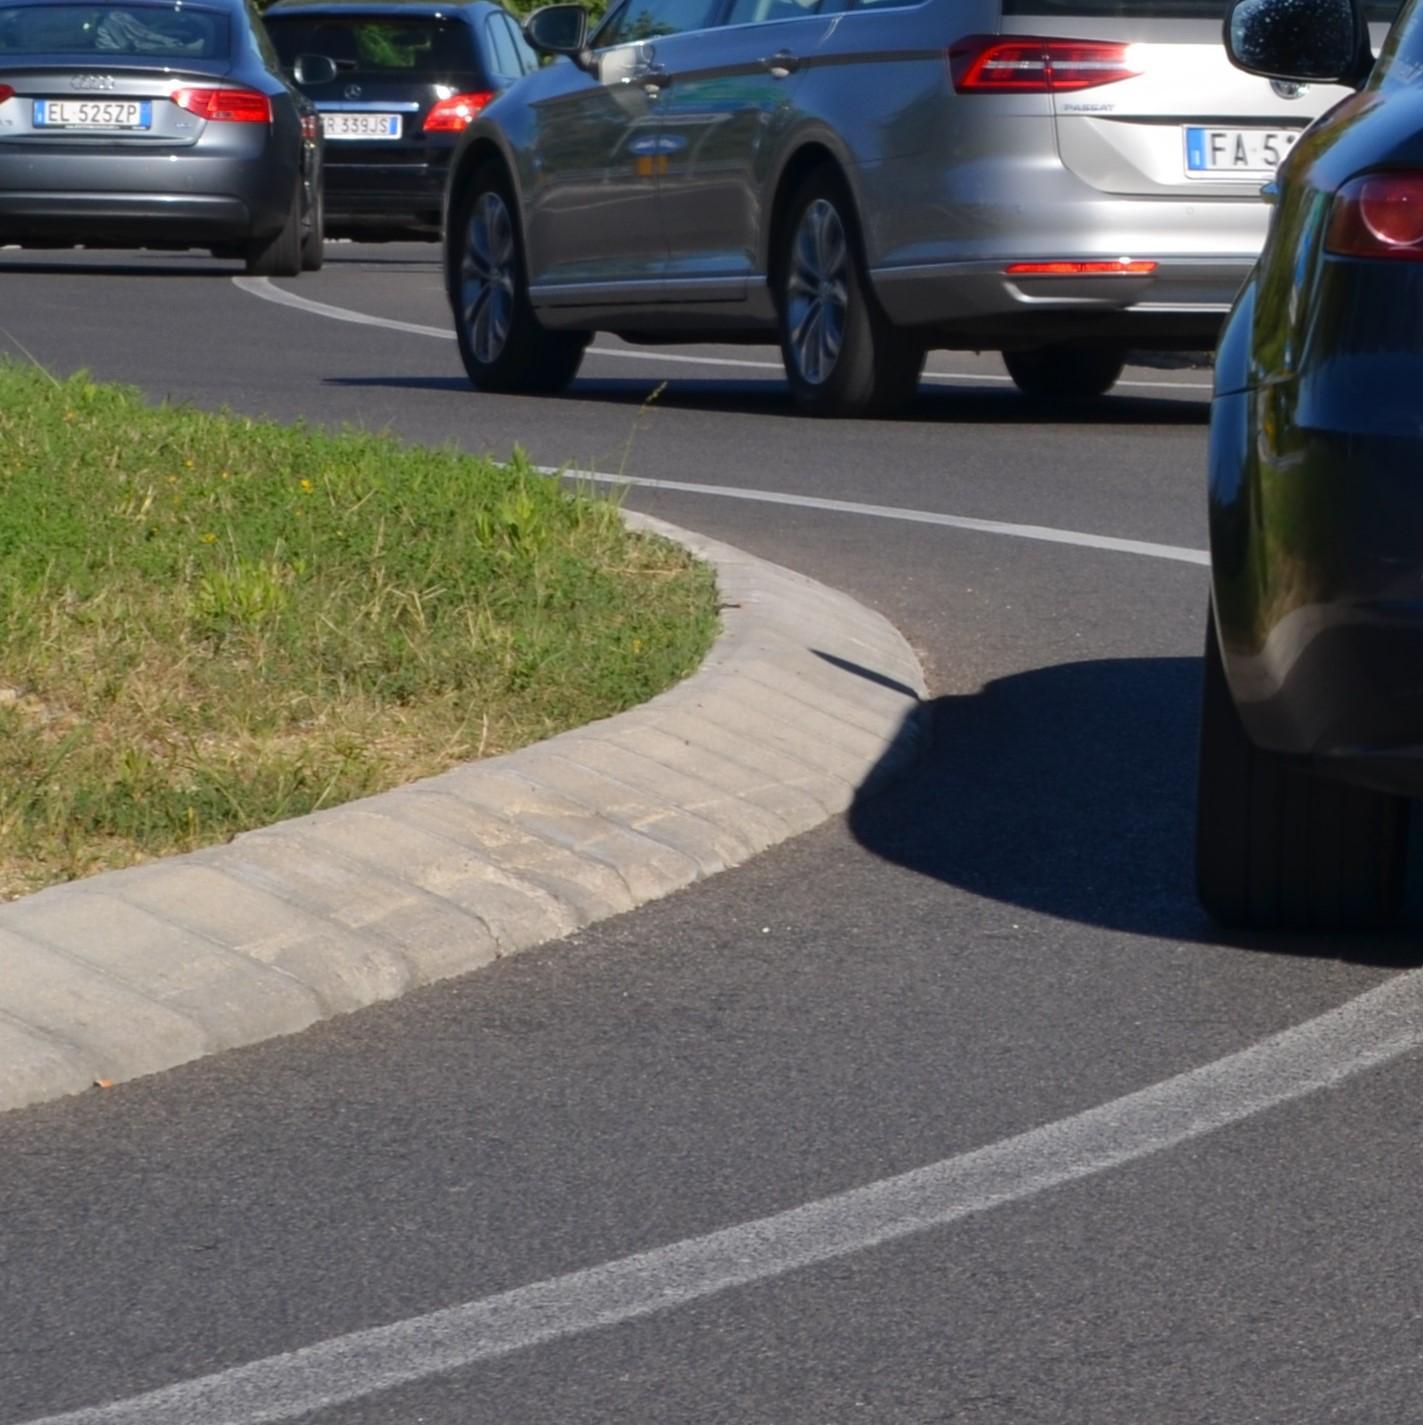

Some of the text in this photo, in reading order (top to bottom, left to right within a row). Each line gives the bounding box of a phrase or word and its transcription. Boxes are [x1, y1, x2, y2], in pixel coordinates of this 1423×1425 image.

[48, 103, 70, 123] EL
[78, 104, 138, 124] 525ZP
[1210, 132, 1249, 166] FA
